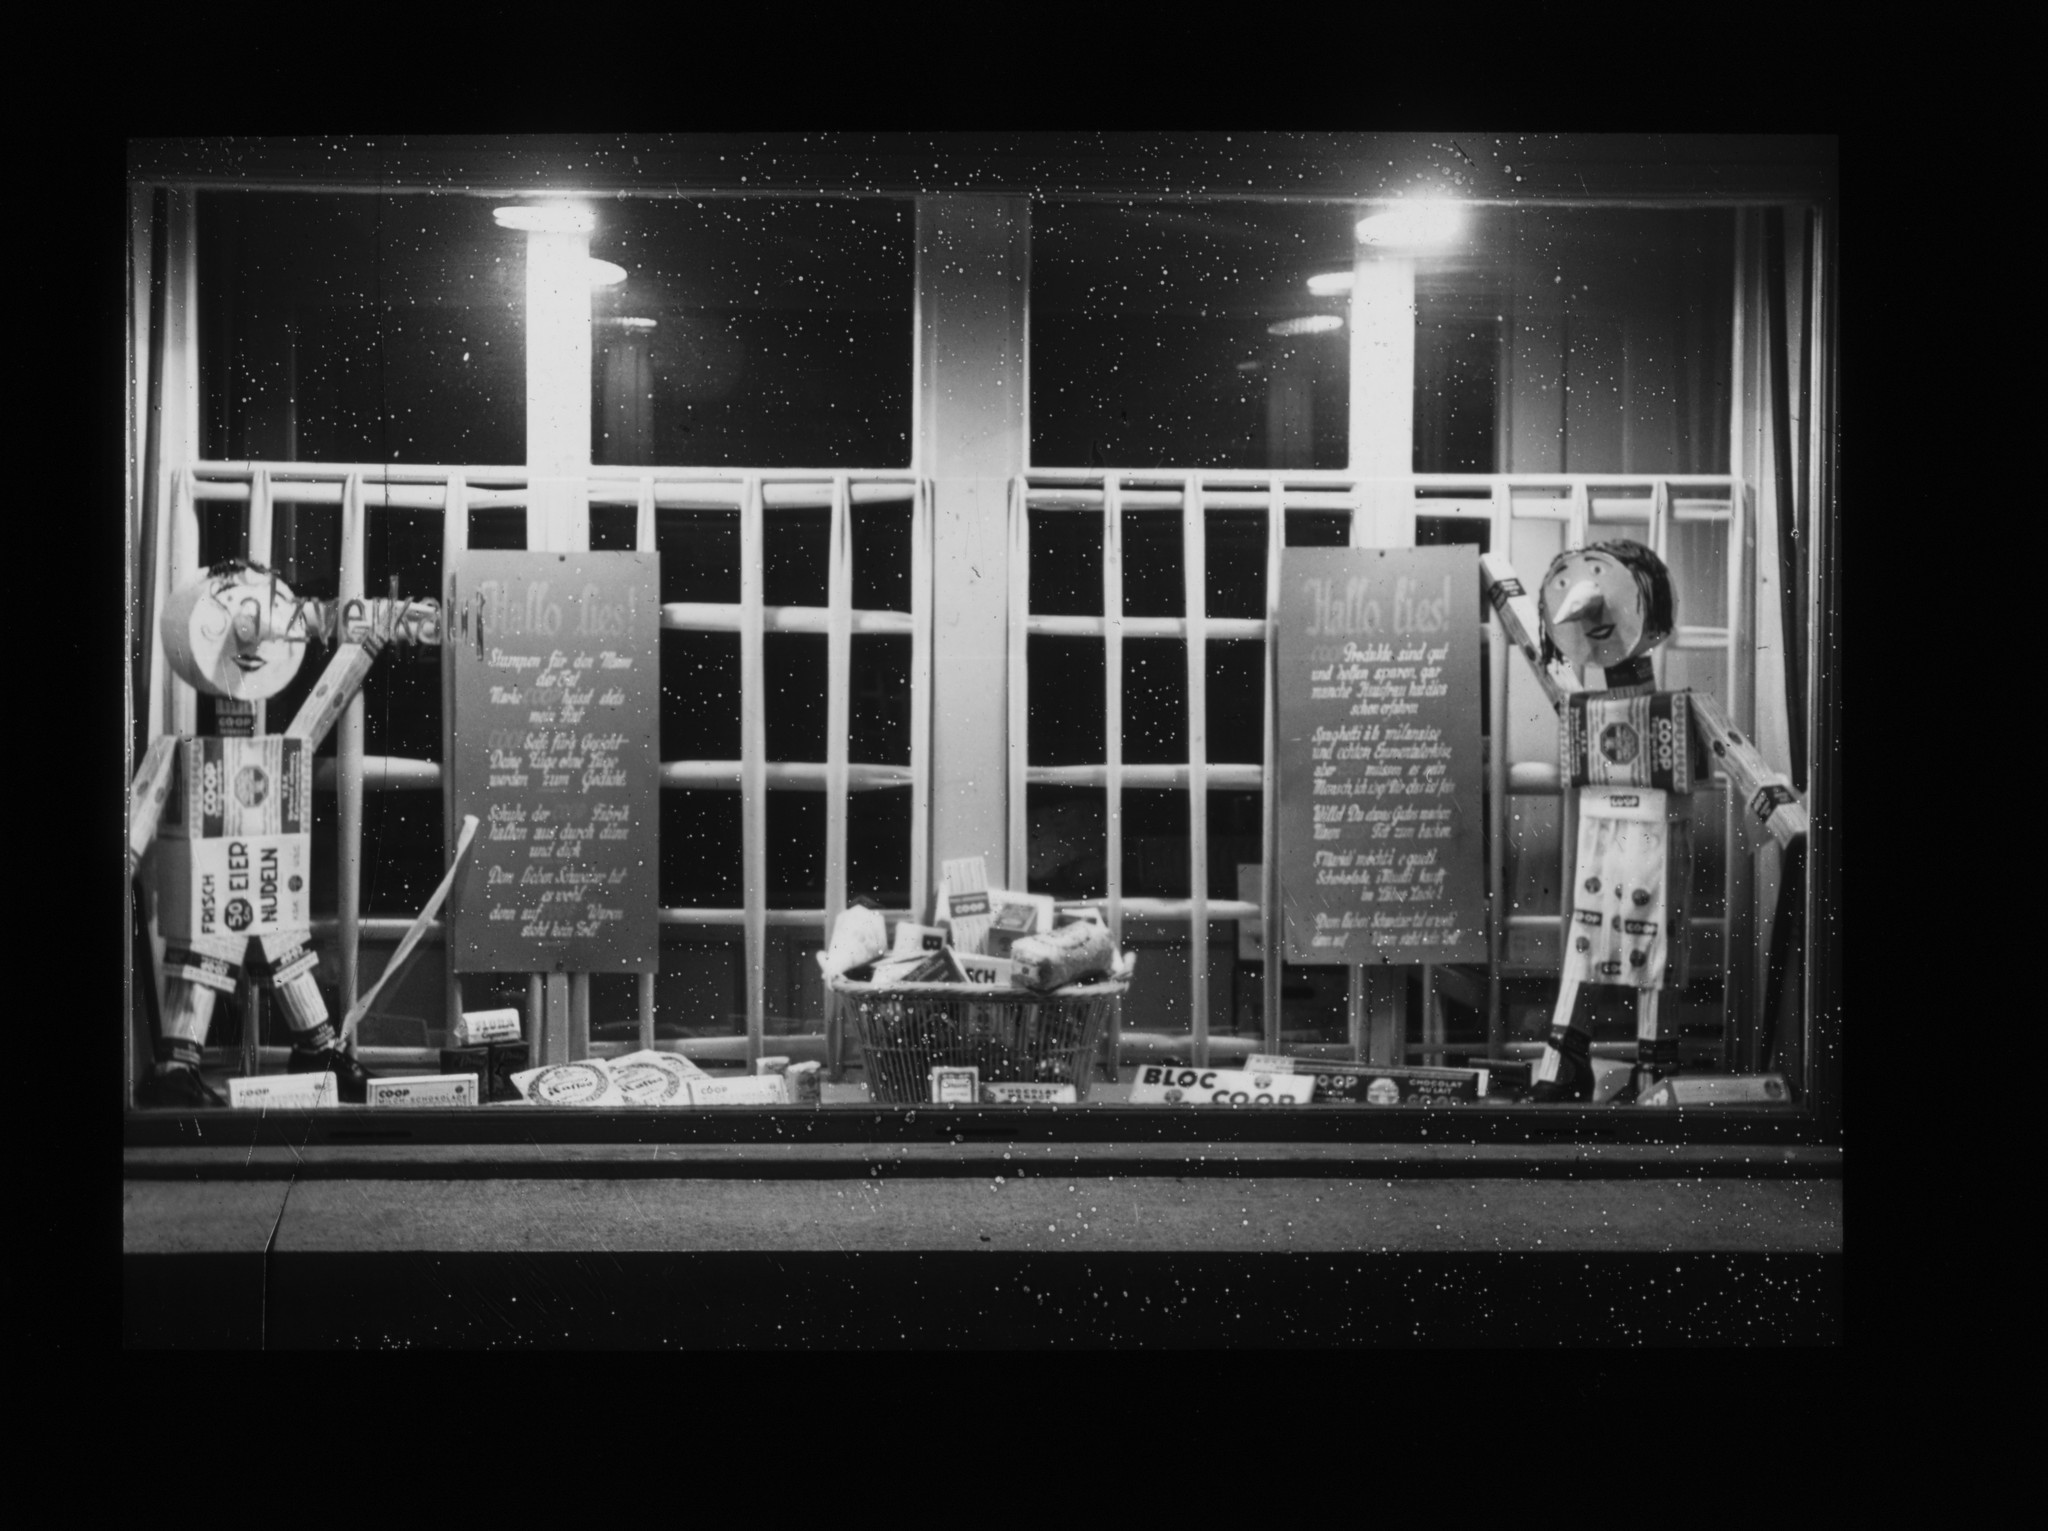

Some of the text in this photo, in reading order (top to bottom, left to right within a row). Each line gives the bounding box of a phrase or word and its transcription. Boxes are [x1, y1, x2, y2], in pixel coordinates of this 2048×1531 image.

[1304, 575, 1380, 636] Hallo
[1311, 664, 1334, 681] und
[1658, 718, 1672, 770] COOP
[203, 761, 217, 816] COOP
[228, 841, 248, 891] EIER
[260, 847, 278, 923] NUDELN
[202, 874, 215, 934] FRISCH
[227, 902, 243, 926] 50
[954, 902, 986, 914] COOP
[1143, 1067, 1217, 1089] BLOC
[1408, 1079, 1463, 1088] CHOCOLAT
[239, 1088, 269, 1097] COOP
[379, 1089, 410, 1098] COOP
[700, 1086, 728, 1095] COOP
